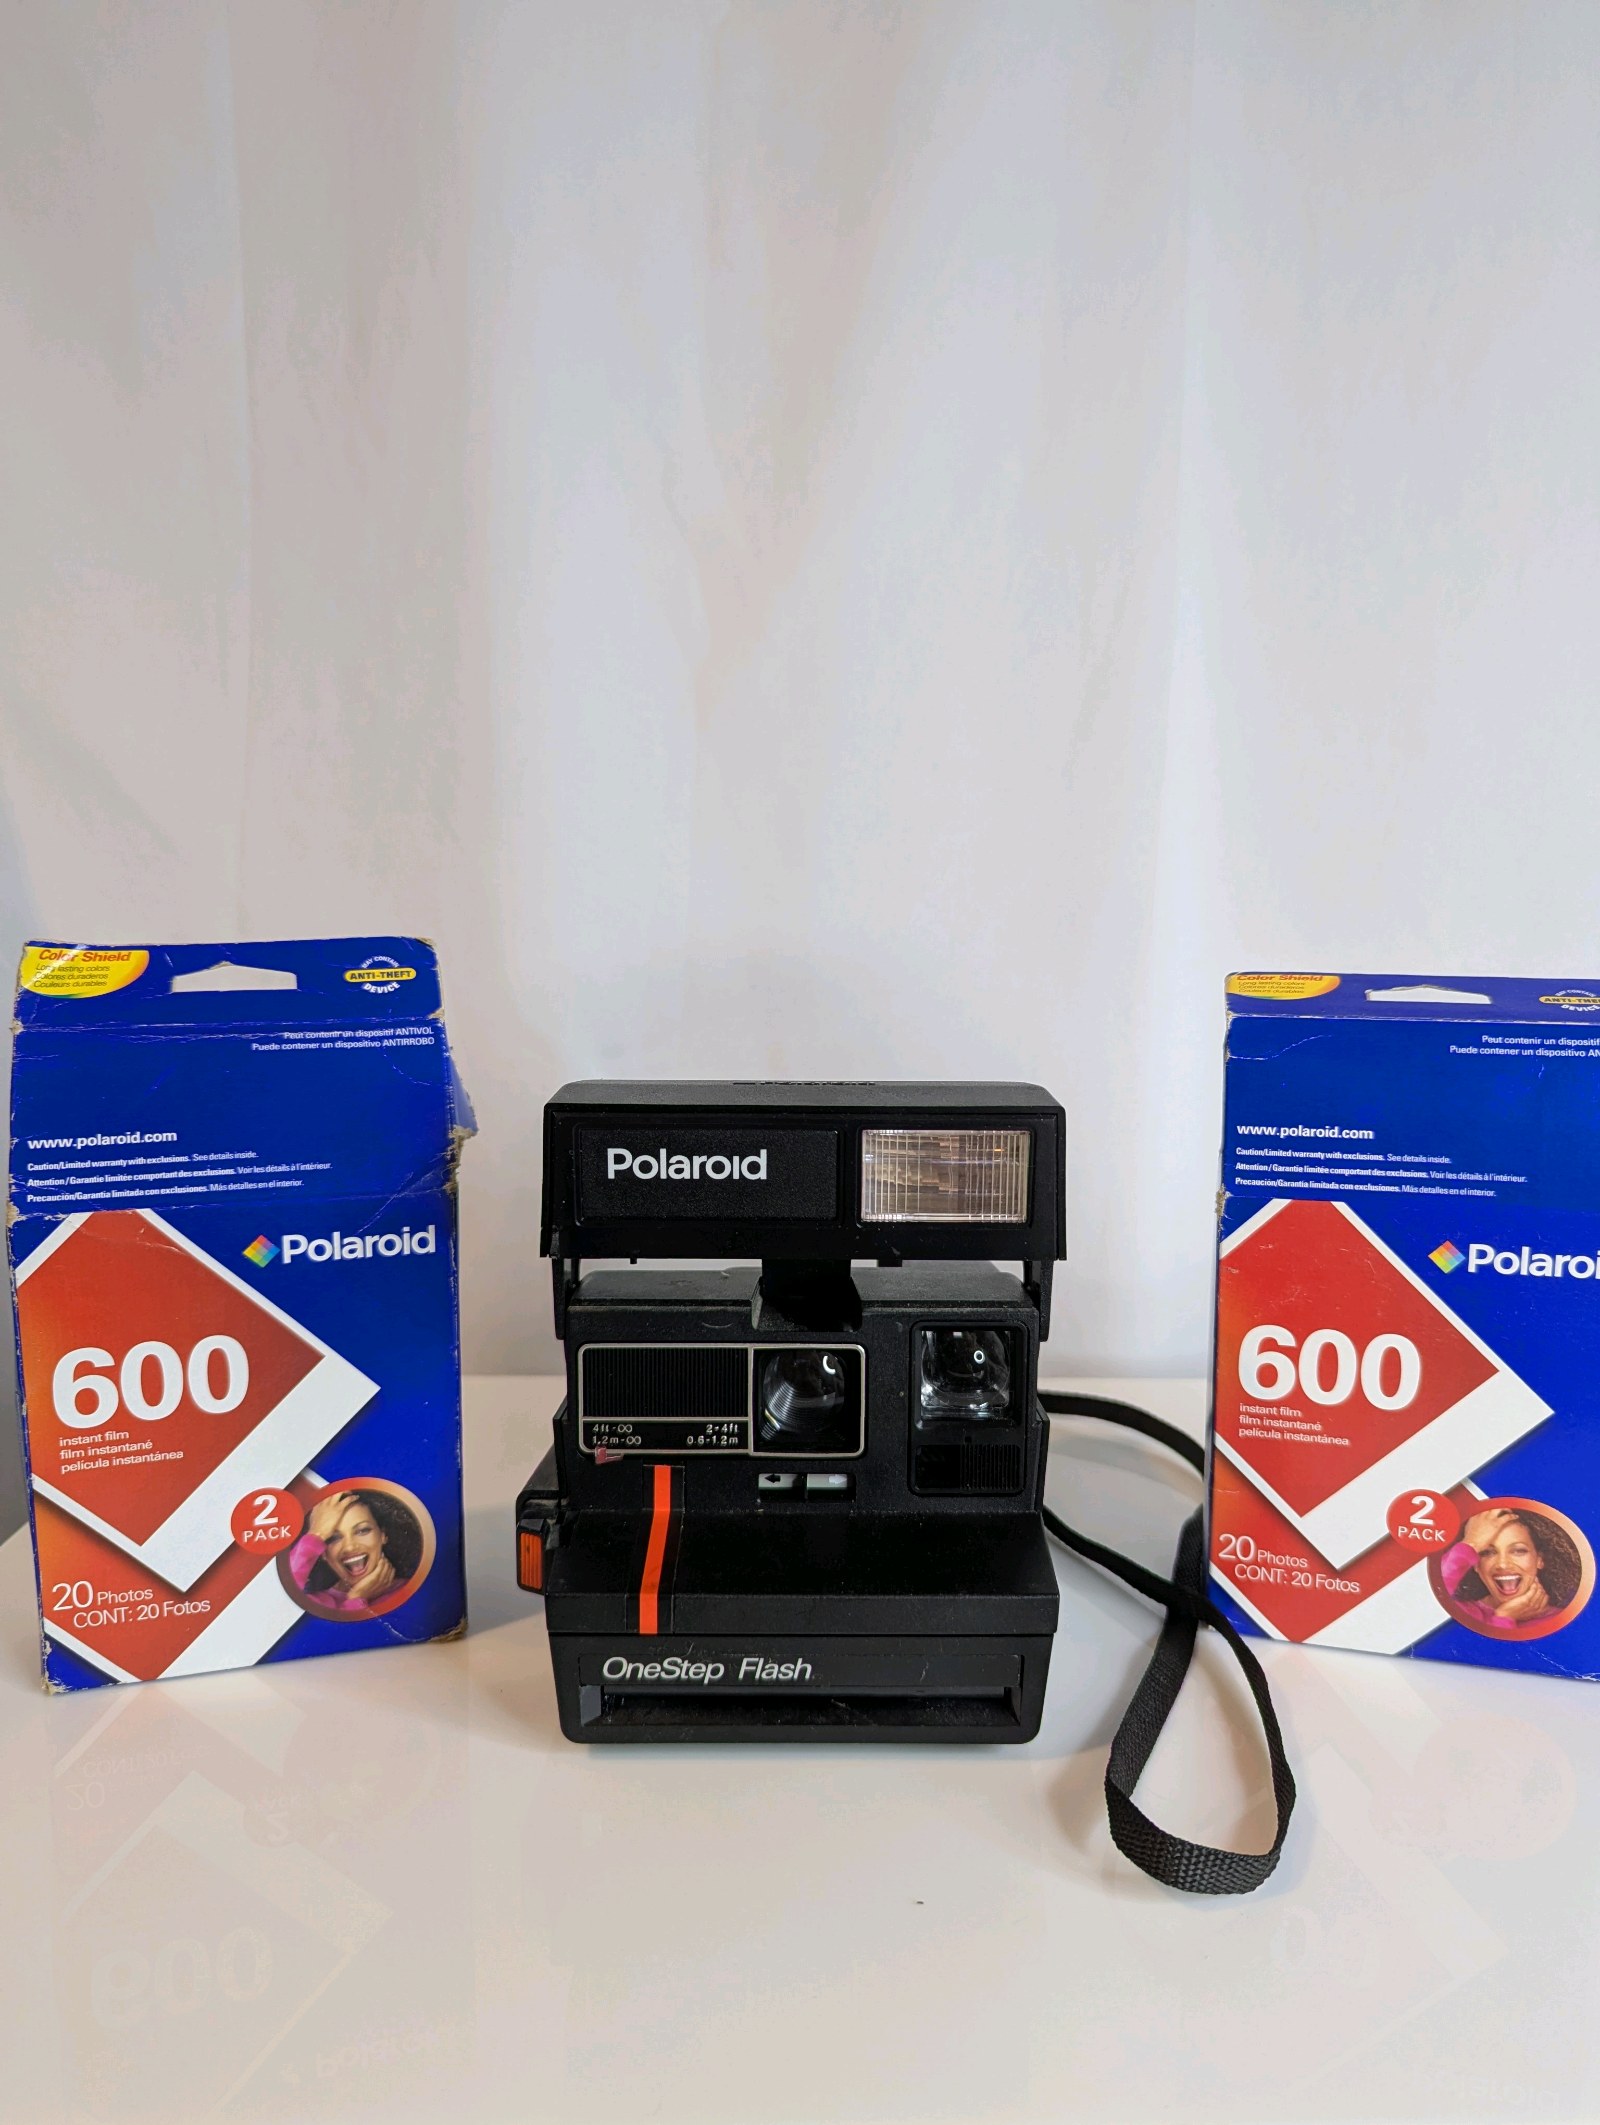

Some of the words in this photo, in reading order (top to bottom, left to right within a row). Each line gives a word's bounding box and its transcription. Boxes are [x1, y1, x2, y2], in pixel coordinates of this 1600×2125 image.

[81, 952, 132, 962] Shield
[58, 964, 83, 973] lasting
[86, 964, 110, 972] colors
[350, 970, 412, 980] ANTI-THEFT
[33, 980, 71, 988] Couleurs
[1279, 974, 1324, 982] Shield
[362, 981, 401, 994] DEVICE
[356, 1028, 394, 1040] dispositif
[395, 1026, 435, 1036] ANTIVOL
[1482, 1035, 1503, 1044] Peut
[1504, 1036, 1541, 1045] contenir
[252, 1043, 280, 1051] Puede
[282, 1041, 320, 1050] contener
[335, 1039, 381, 1050] dispositivo
[382, 1037, 435, 1047] ANTIRROBO
[1450, 1045, 1478, 1054] Puede
[1479, 1046, 1519, 1055] contener
[1535, 1048, 1586, 1058] dispositivo
[27, 1131, 178, 1150] www.polaroid.com
[1236, 1125, 1375, 1139] www.polaroid.com
[92, 1159, 127, 1168] warranty
[128, 1156, 146, 1165] with
[147, 1154, 191, 1164] exclusions.
[192, 1153, 208, 1161] See
[208, 1152, 234, 1161] details
[234, 1150, 260, 1159] inside.
[606, 1148, 768, 1180] Polaroid
[1292, 1151, 1325, 1160] warranty
[1325, 1151, 1342, 1159] with
[1343, 1152, 1385, 1161] exclusions.
[1387, 1153, 1401, 1161] See
[1402, 1154, 1427, 1163] details
[1427, 1155, 1452, 1164] inside.
[133, 1171, 178, 1182] comportant
[178, 1170, 193, 1178] des
[237, 1166, 253, 1175] Voir
[254, 1165, 266, 1174] les
[266, 1163, 290, 1173] détails
[290, 1163, 296, 1171] à
[1329, 1167, 1371, 1177] comportant
[1429, 1170, 1445, 1179] Voir
[1445, 1171, 1457, 1180] les
[1457, 1171, 1483, 1181] détails
[1483, 1172, 1489, 1181] à
[111, 1187, 144, 1198] limitada
[144, 1187, 159, 1195] con
[209, 1182, 227, 1192] Más
[227, 1181, 257, 1191] detalles
[257, 1181, 268, 1189] en
[268, 1179, 276, 1188] el
[1309, 1180, 1339, 1190] limitada
[1401, 1184, 1419, 1193] Más
[1419, 1184, 1449, 1195] detalles
[1449, 1187, 1459, 1195] en
[1460, 1187, 1467, 1196] el
[282, 1225, 436, 1264] Polaroid
[1467, 1243, 1600, 1280] Polaroi
[1238, 1324, 1422, 1411] 600
[51, 1334, 250, 1430] 600
[1239, 1403, 1279, 1416] instant
[1279, 1405, 1302, 1418] film
[1238, 1414, 1261, 1427] film
[1262, 1416, 1322, 1432] instantané
[58, 1431, 103, 1447] instant
[104, 1428, 130, 1442] film
[1238, 1425, 1282, 1443] película
[1283, 1429, 1350, 1447] instantánea
[59, 1446, 86, 1460] film
[87, 1438, 153, 1456] instantané
[60, 1456, 111, 1475] película
[111, 1449, 184, 1467] instantánea
[253, 1493, 280, 1525] 2
[1410, 1495, 1435, 1526] 2
[243, 1526, 293, 1544] PACK
[1397, 1525, 1446, 1543] PACK
[1218, 1532, 1257, 1562] 20
[1257, 1549, 1308, 1569] Photos
[1234, 1562, 1288, 1585] CONT:
[1291, 1569, 1313, 1588] 20
[1315, 1573, 1361, 1594] Fotos
[51, 1580, 95, 1612] 20
[96, 1586, 154, 1605] Photos
[73, 1607, 134, 1629] CONT:
[136, 1603, 161, 1622] 20
[163, 1598, 212, 1618] Fotos
[602, 1656, 725, 1685] OneStep
[738, 1657, 813, 1680] Flash
